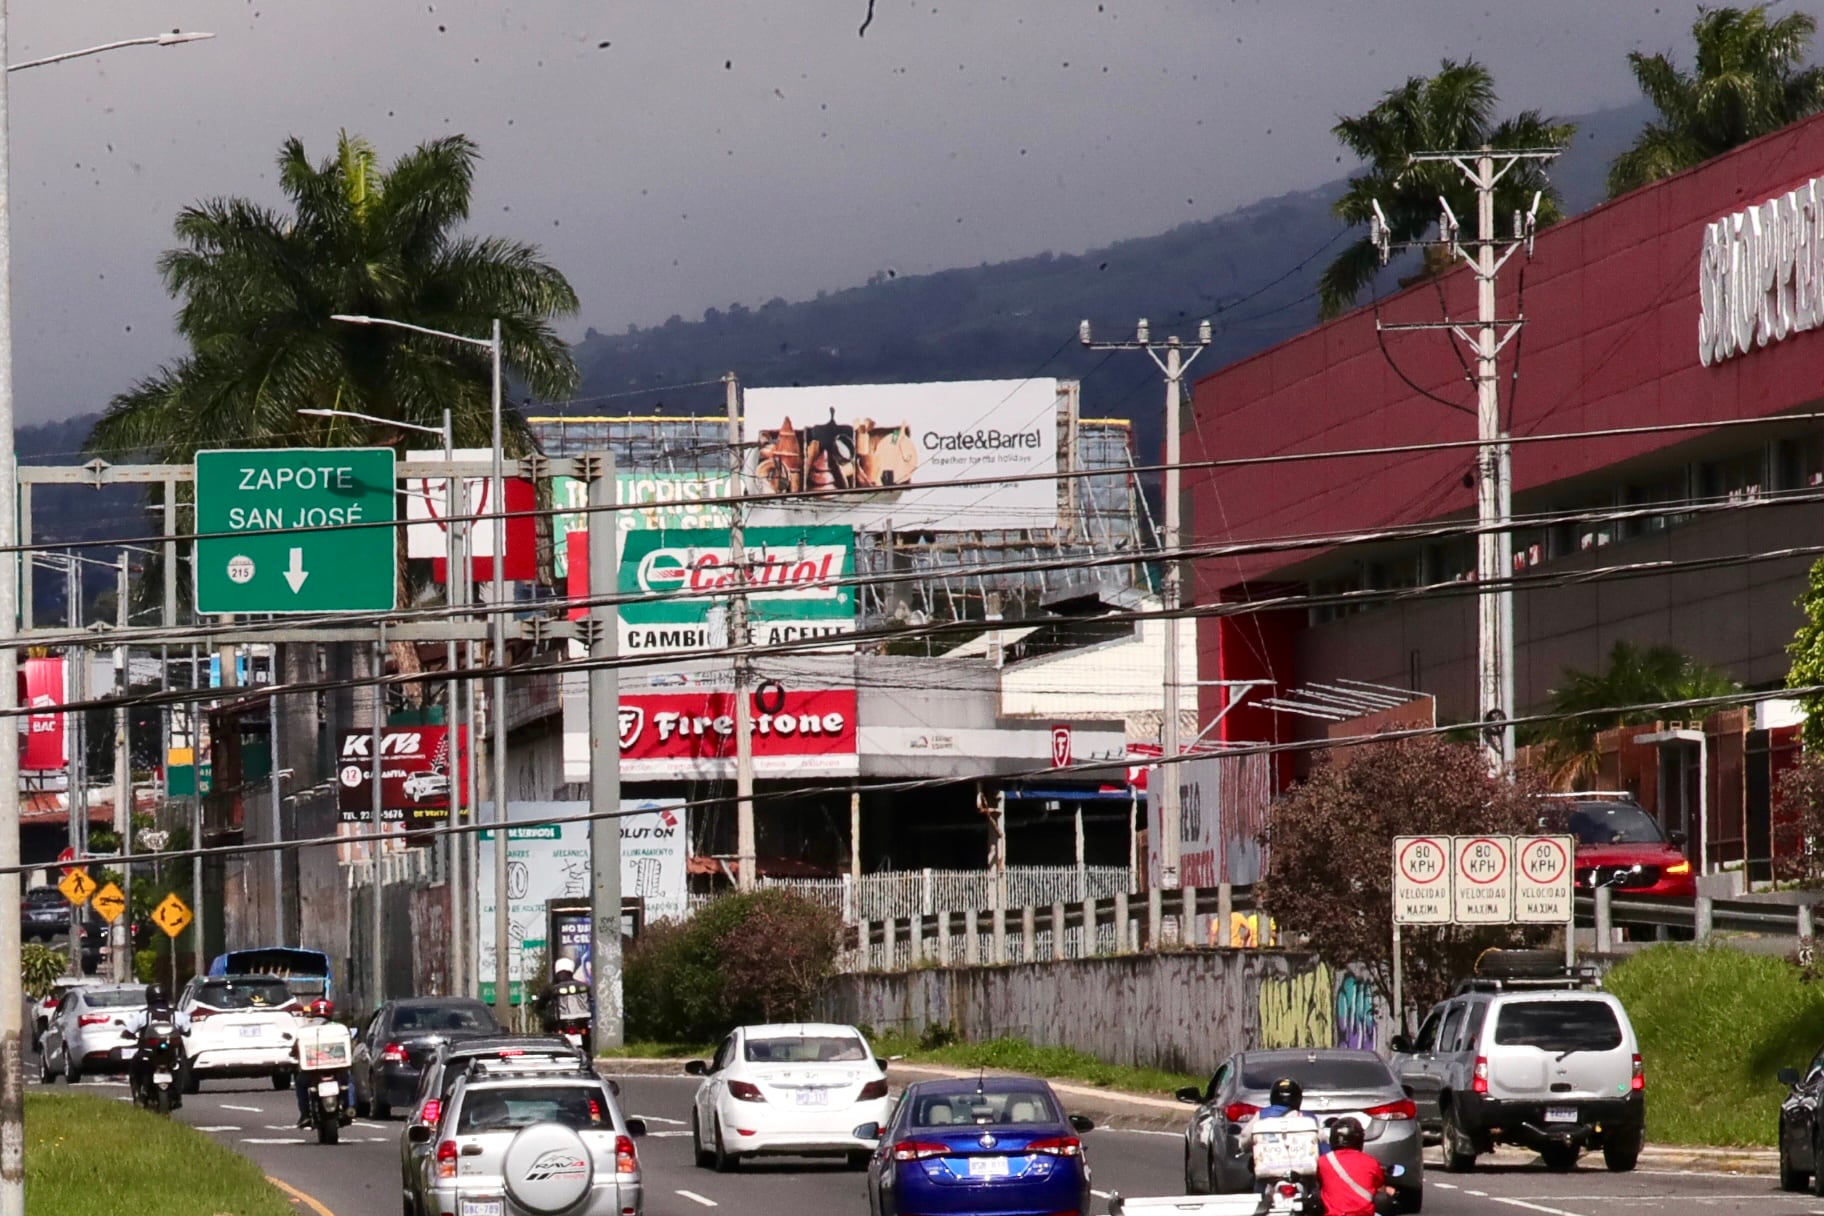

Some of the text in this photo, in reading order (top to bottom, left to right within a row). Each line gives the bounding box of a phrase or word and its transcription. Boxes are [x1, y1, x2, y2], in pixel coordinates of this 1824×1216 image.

[922, 428, 1042, 450] Crate&Barrel
[238, 466, 353, 490] ZAPOTE
[228, 502, 363, 529] SAN JOSÉ
[231, 568, 250, 578] 215
[689, 552, 835, 592] Catrol
[627, 626, 712, 649] CAMBI
[33, 721, 56, 732] BAC
[342, 732, 422, 757] KYB
[1415, 845, 1431, 858] 80
[1475, 845, 1491, 858] 80
[1536, 845, 1551, 858] 60
[1409, 860, 1435, 873] KPH
[1470, 859, 1496, 873] KPH
[1531, 859, 1556, 872] KPH
[1400, 888, 1446, 899] VELOCIDAD
[1460, 888, 1506, 899] VELOCIDAD
[1521, 887, 1566, 898] VELOCIDAD
[1407, 904, 1438, 915] MAXIMA
[1467, 903, 1498, 914] MAXIMA
[1528, 903, 1558, 914] MAXIMA
